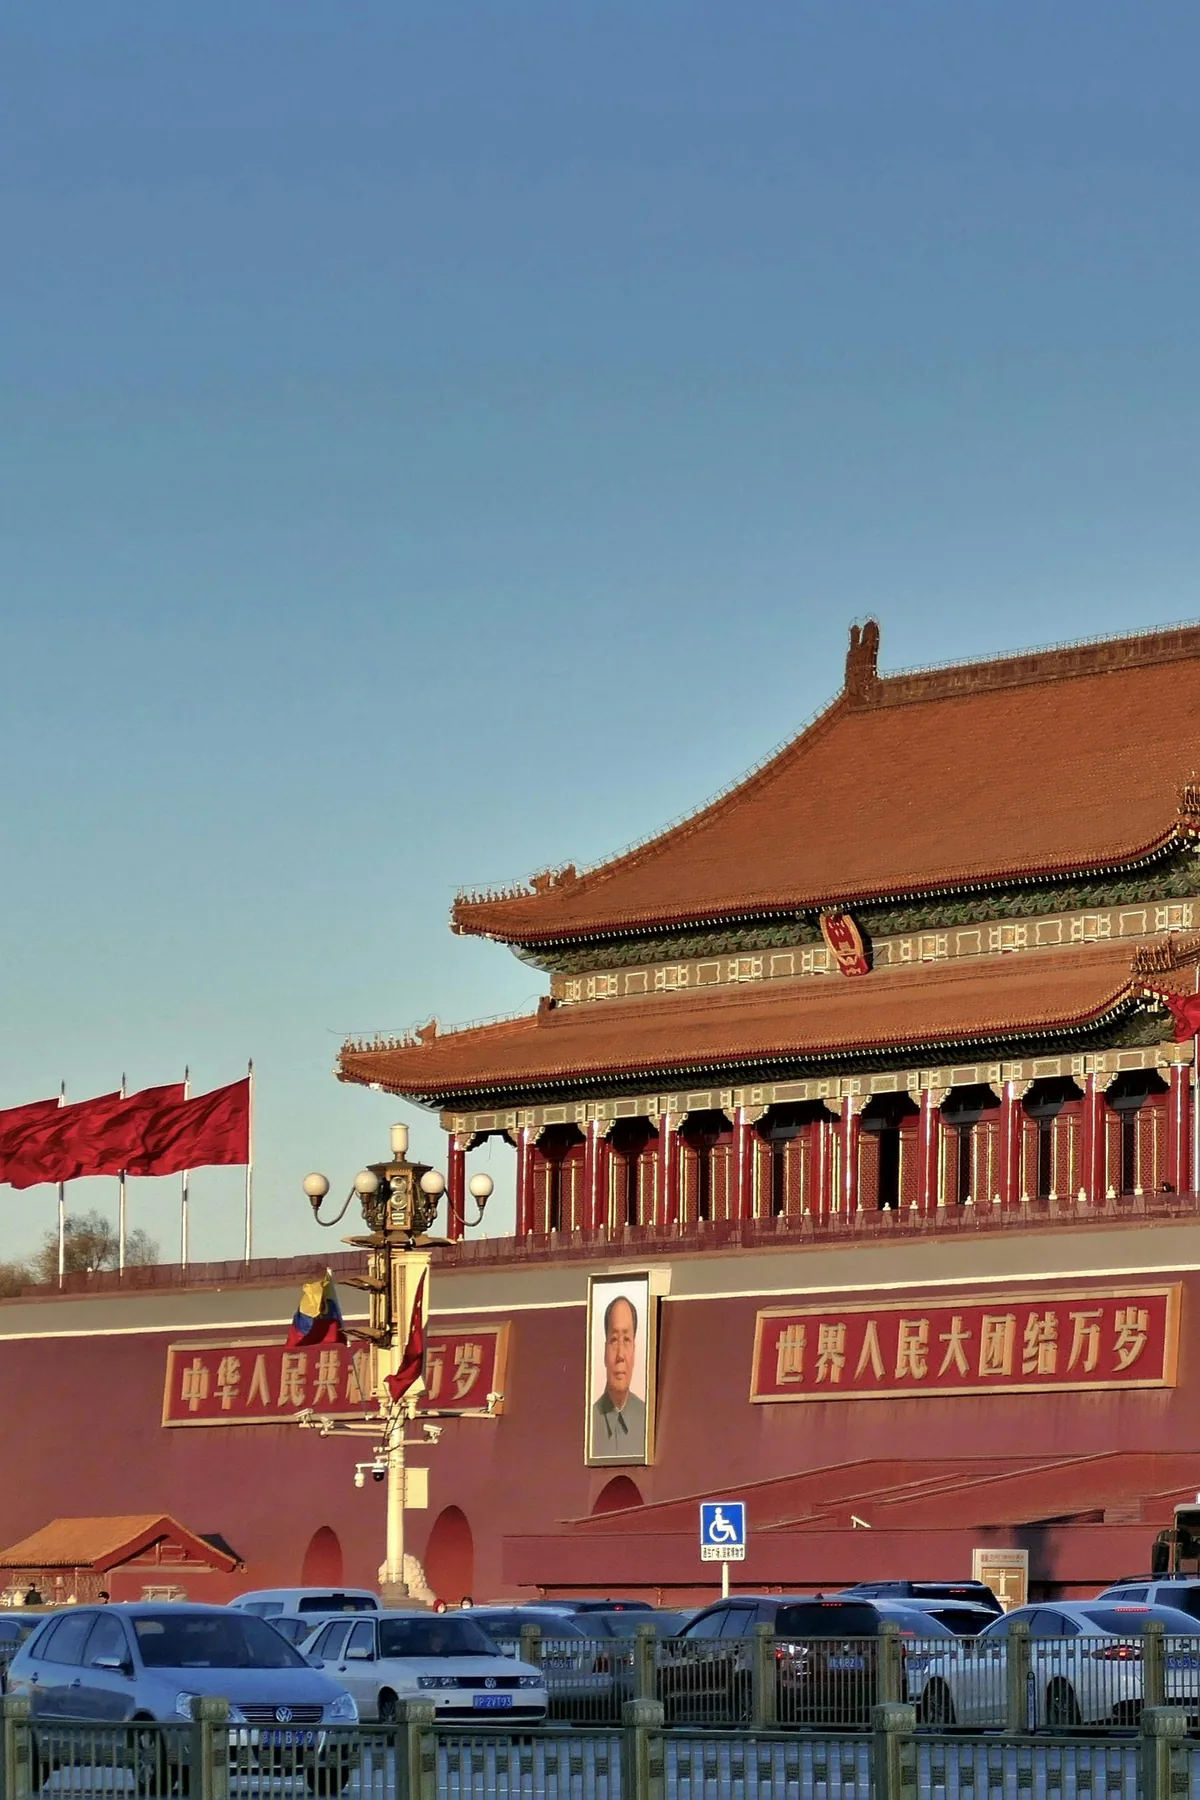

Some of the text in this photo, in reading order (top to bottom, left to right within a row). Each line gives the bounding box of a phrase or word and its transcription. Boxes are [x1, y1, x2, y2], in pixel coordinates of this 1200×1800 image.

[181, 1342, 483, 1412] 中华人民共和万岁
[775, 1306, 1150, 1386] 世界人民大团结万岁
